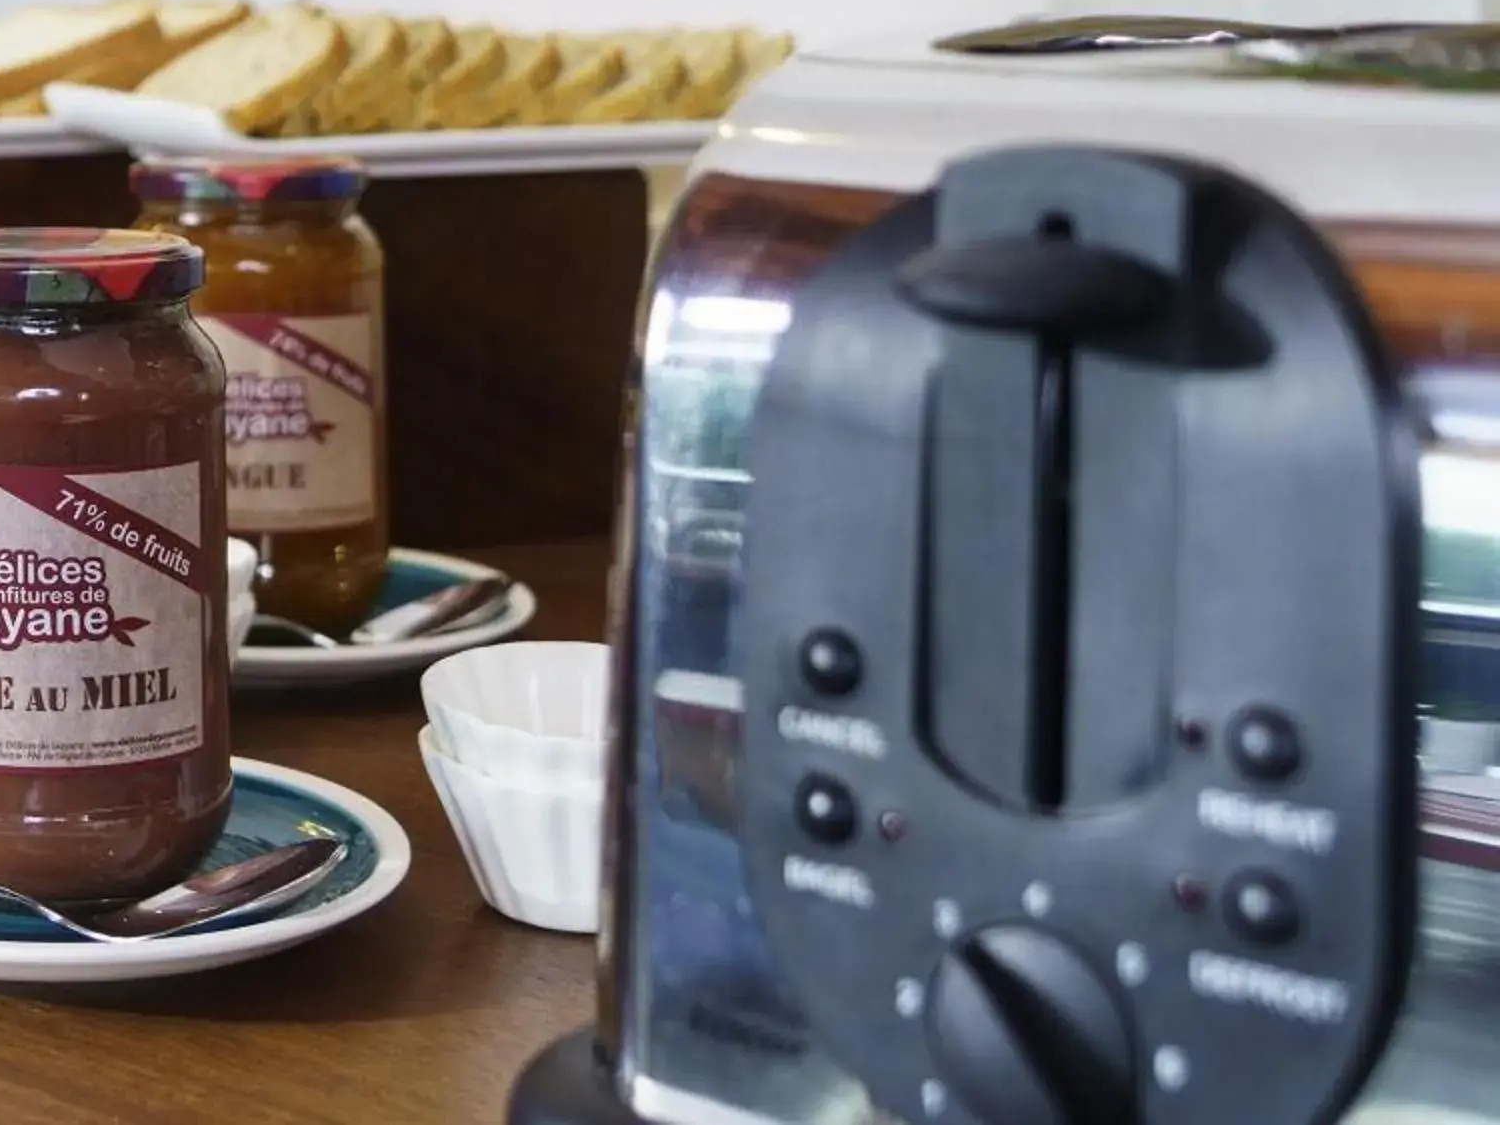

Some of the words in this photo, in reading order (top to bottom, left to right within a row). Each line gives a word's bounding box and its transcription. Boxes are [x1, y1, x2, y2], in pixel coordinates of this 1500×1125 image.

[226, 374, 304, 399] élices
[226, 412, 308, 441] yane
[55, 489, 107, 532] 71%
[110, 520, 139, 548] de
[143, 534, 192, 576] fruits
[79, 585, 106, 602] de
[25, 686, 69, 712] AU
[80, 667, 178, 711] MIEL
